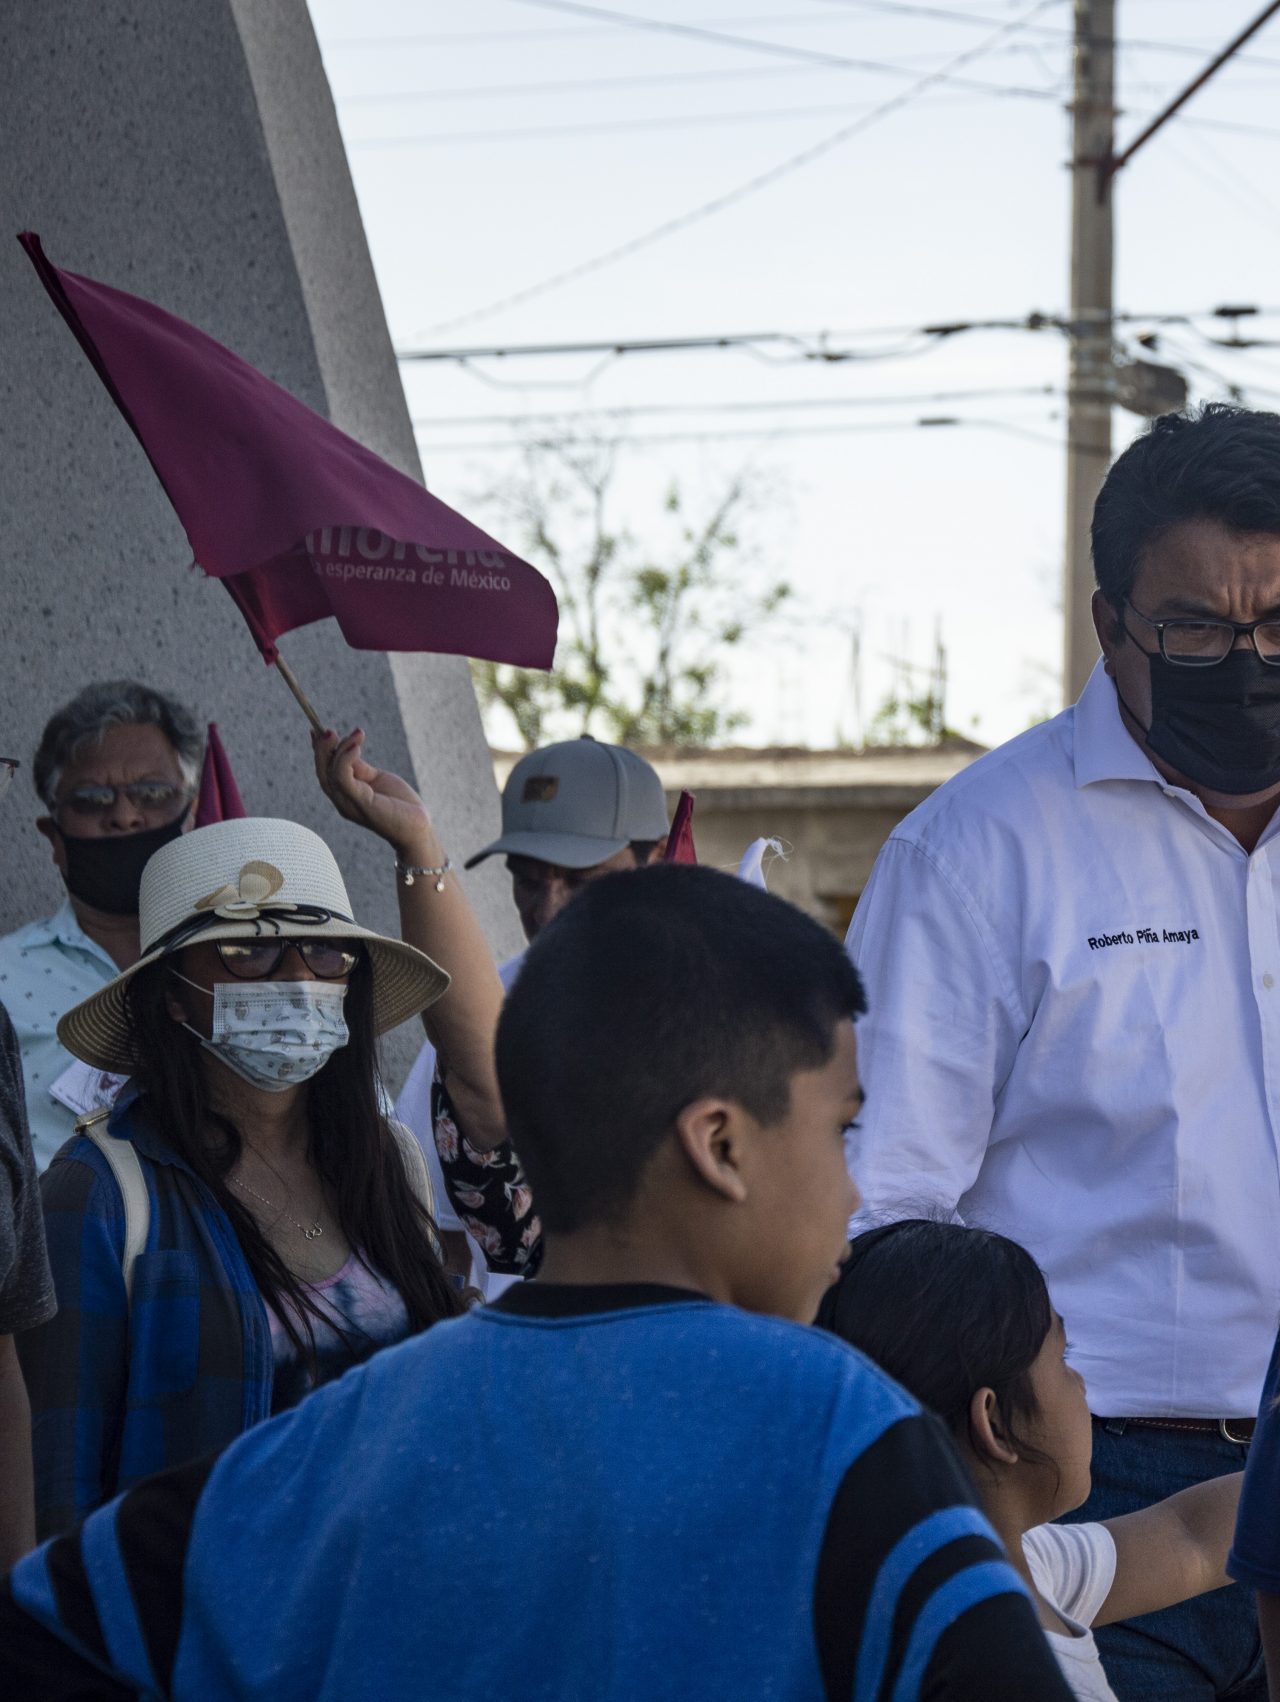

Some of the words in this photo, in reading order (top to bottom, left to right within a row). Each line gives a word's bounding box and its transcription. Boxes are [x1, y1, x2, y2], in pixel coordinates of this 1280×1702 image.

[326, 562, 417, 583] esperanza
[422, 566, 444, 586] de
[450, 568, 511, 591] México
[1088, 931, 1134, 950] Roberto
[1136, 928, 1160, 944] Piña
[1162, 929, 1200, 944] Amaya
